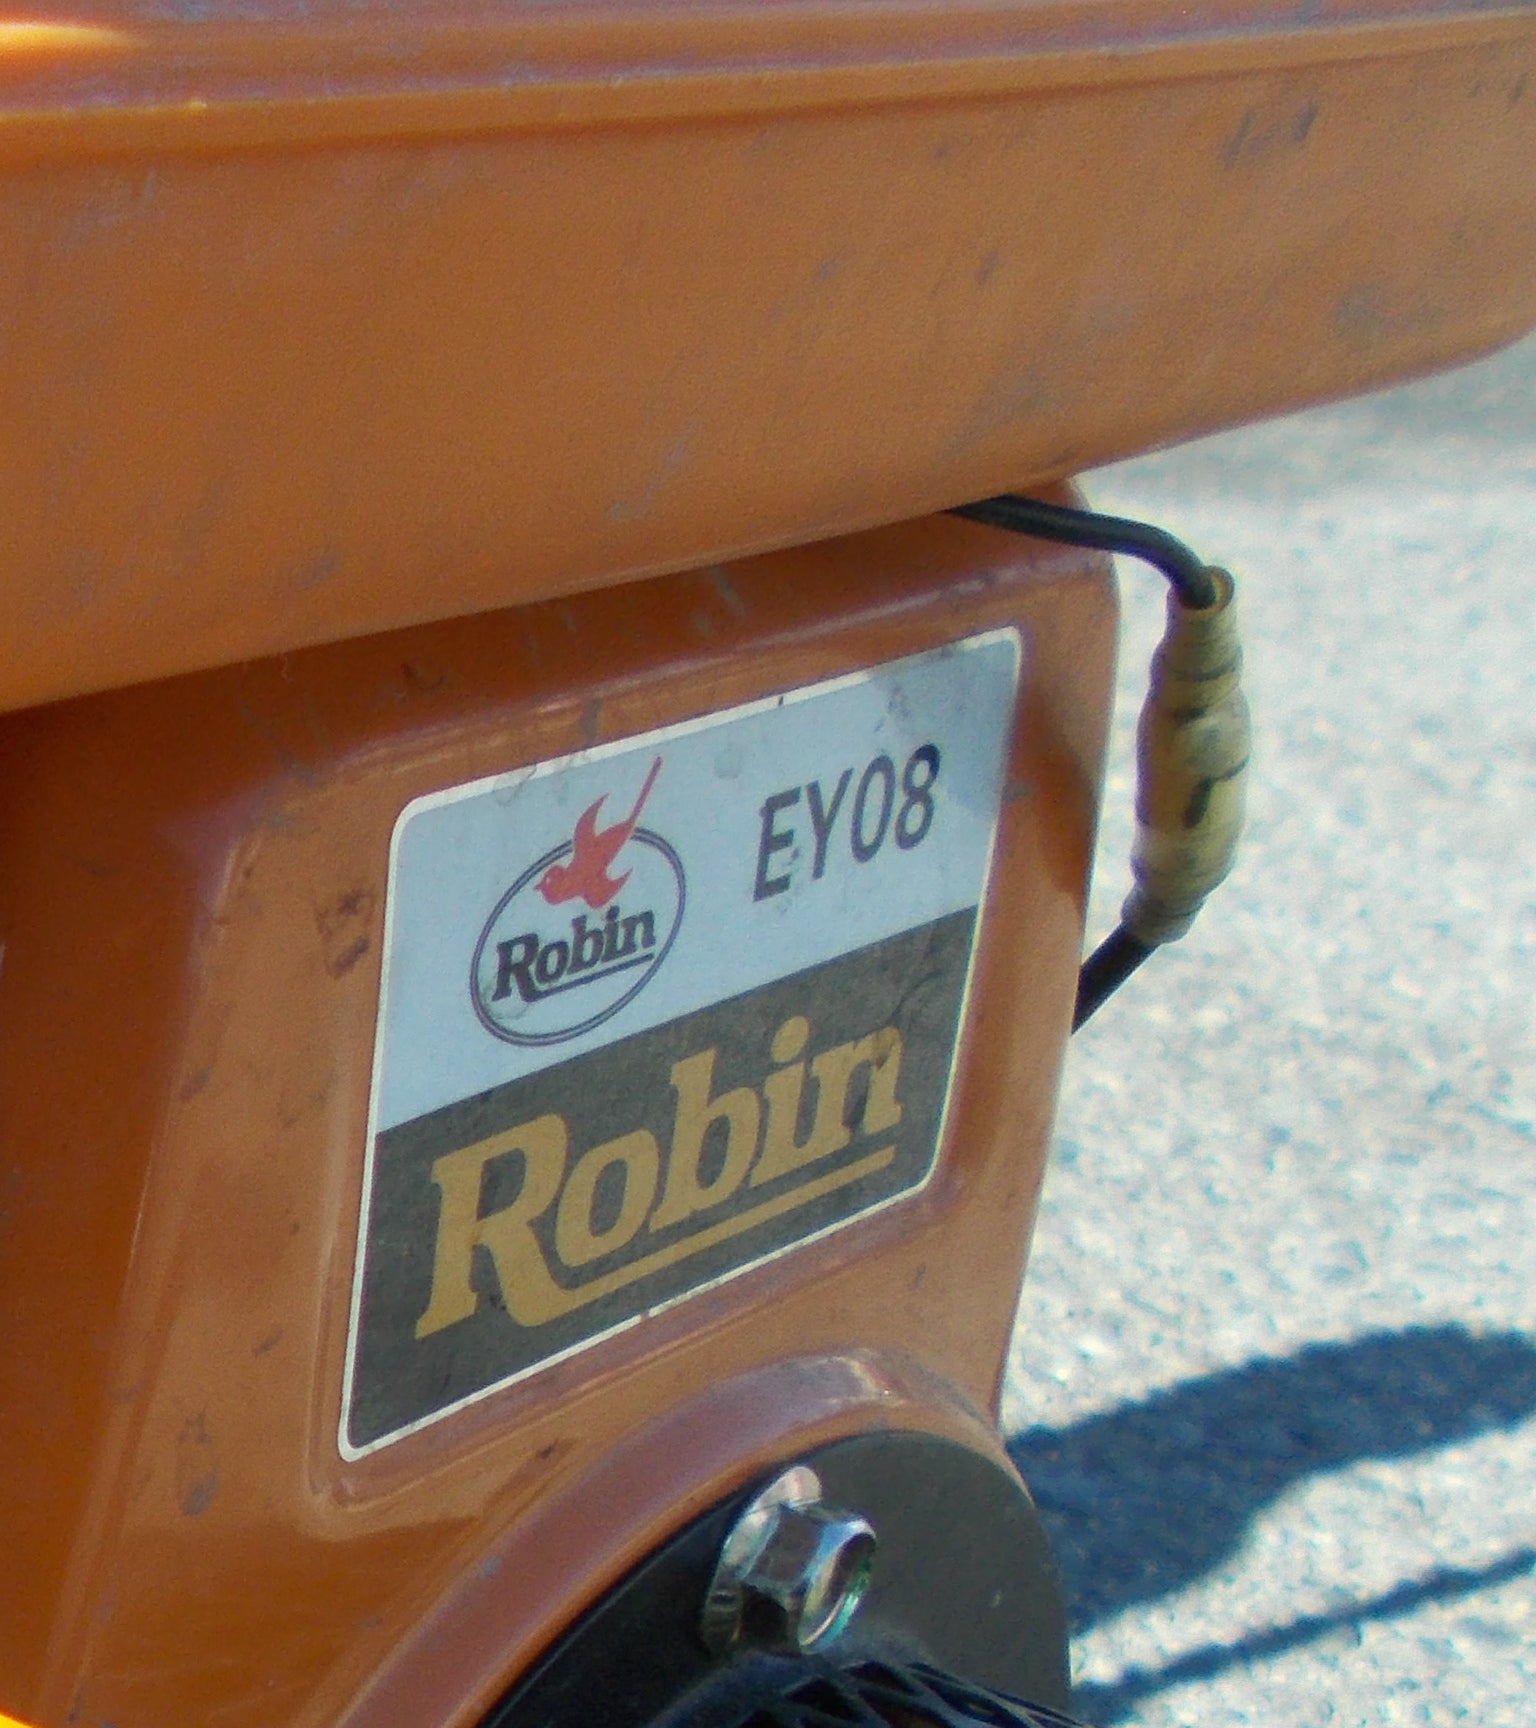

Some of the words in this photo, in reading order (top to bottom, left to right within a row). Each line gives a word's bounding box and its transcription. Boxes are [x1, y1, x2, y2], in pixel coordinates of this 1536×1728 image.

[752, 742, 942, 903] EY08
[490, 906, 658, 1002] Robin
[415, 1014, 902, 1338] Robin
